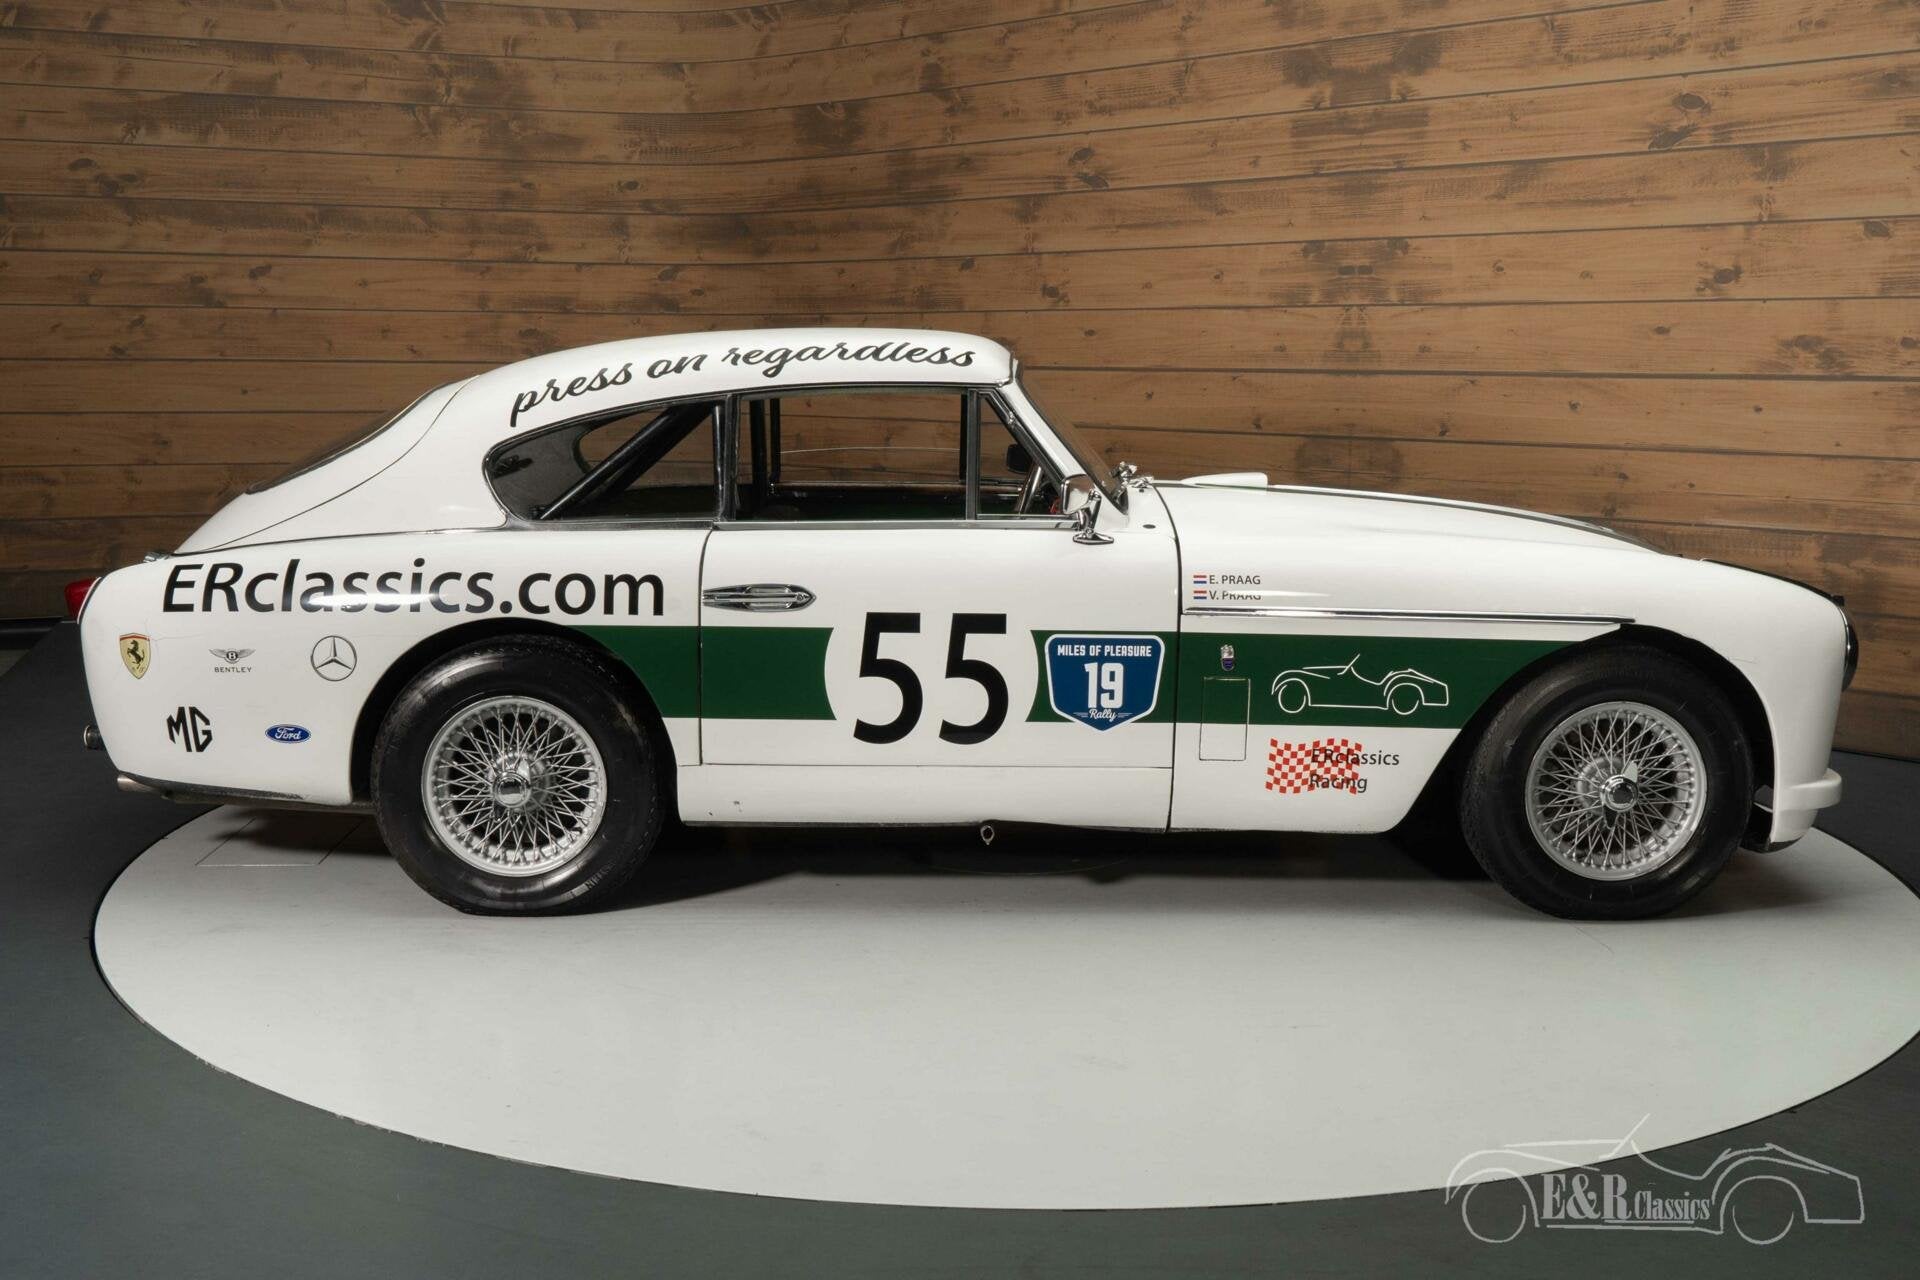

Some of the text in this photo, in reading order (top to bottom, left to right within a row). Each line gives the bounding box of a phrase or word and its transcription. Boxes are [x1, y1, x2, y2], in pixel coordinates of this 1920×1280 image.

[510, 341, 976, 427] press on regardless
[162, 558, 665, 617] ERclassics.com
[1209, 575, 1261, 585] E. PRAAG
[1209, 591, 1219, 600] V.
[1057, 645, 1152, 657] MILES OF PLEASURE
[853, 612, 1009, 745] 55
[1083, 662, 1125, 709] 19
[1088, 708, 1117, 722] Rally
[167, 706, 213, 752] MG
[274, 727, 302, 741] Ford
[1311, 748, 1400, 766] ERclassics
[1309, 774, 1368, 793] Racing
